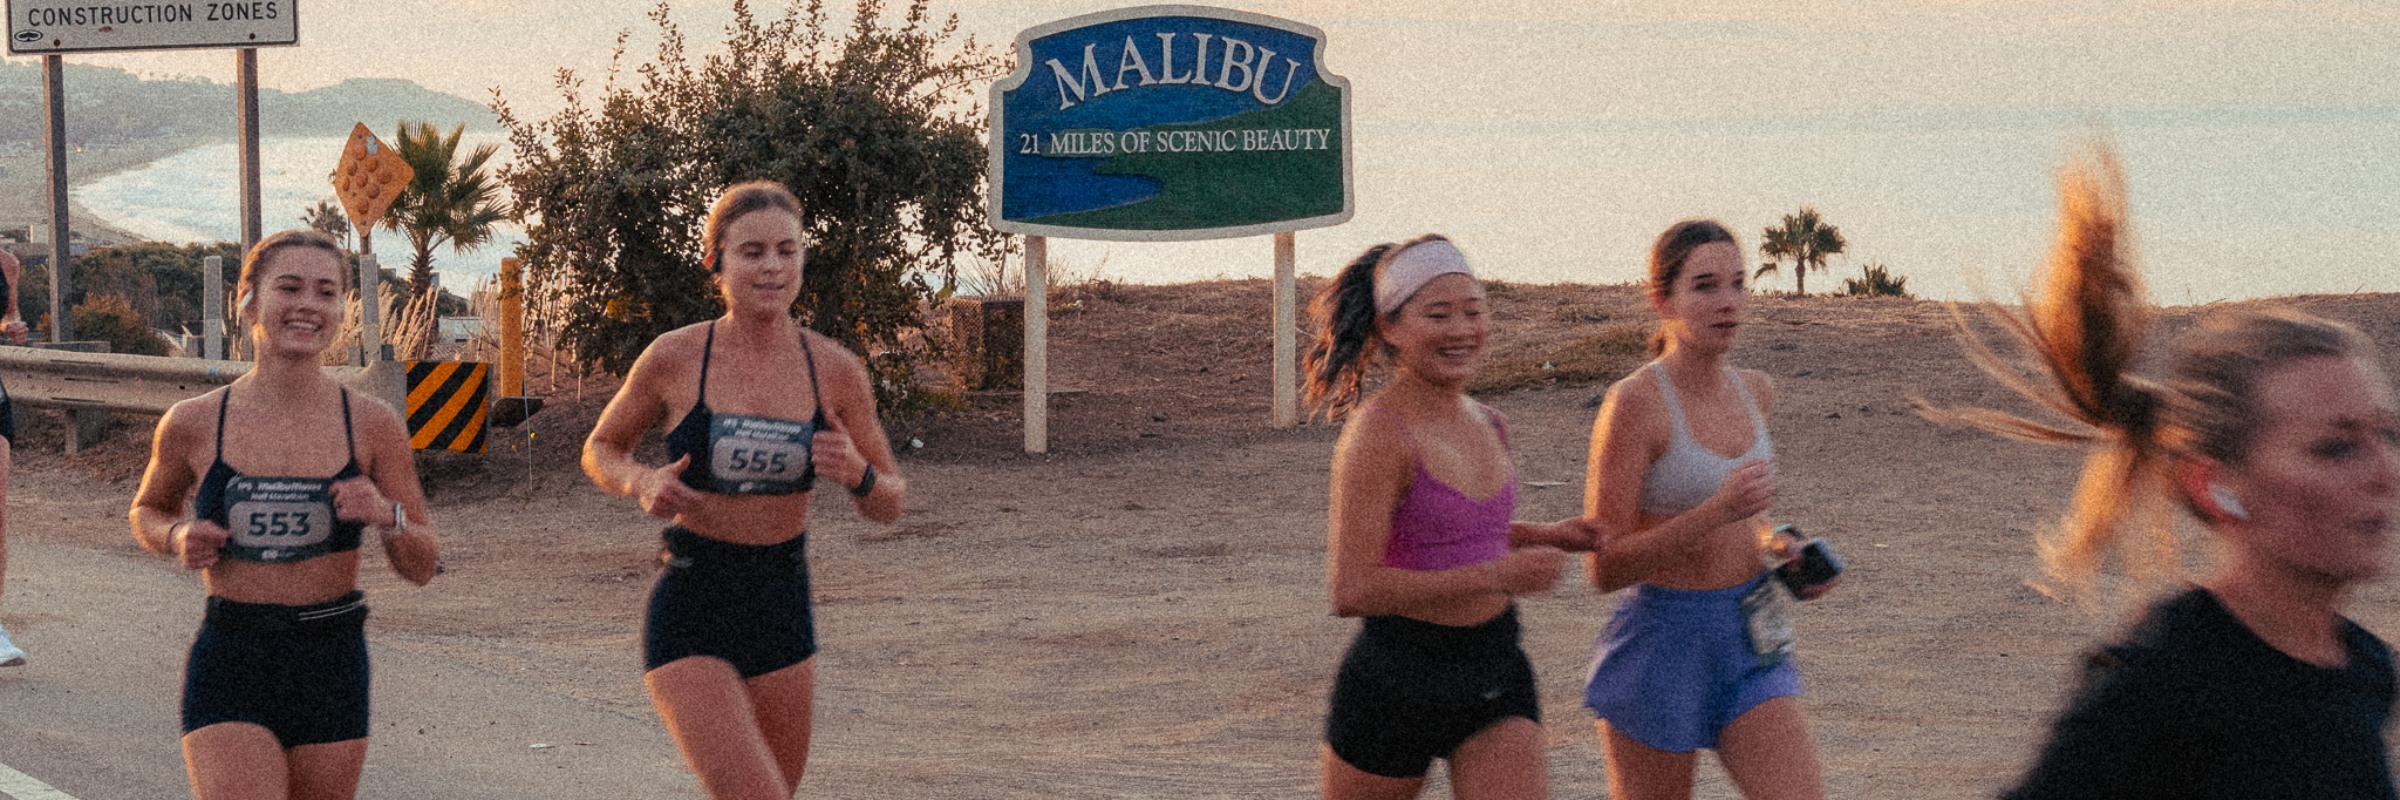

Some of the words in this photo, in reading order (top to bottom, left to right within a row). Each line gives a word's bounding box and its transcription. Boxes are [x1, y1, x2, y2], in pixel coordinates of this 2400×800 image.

[28, 4, 192, 26] CONSTRUCTION
[206, 2, 278, 21] ZONES
[1045, 32, 1300, 111] MALIBU
[1020, 133, 1041, 154] 21
[1050, 132, 1115, 154] MILES
[1121, 131, 1151, 153] OF
[1156, 129, 1237, 152] SCENIC
[1242, 128, 1331, 151] BEAUTY
[729, 447, 788, 473] 555
[248, 511, 311, 537] 553
